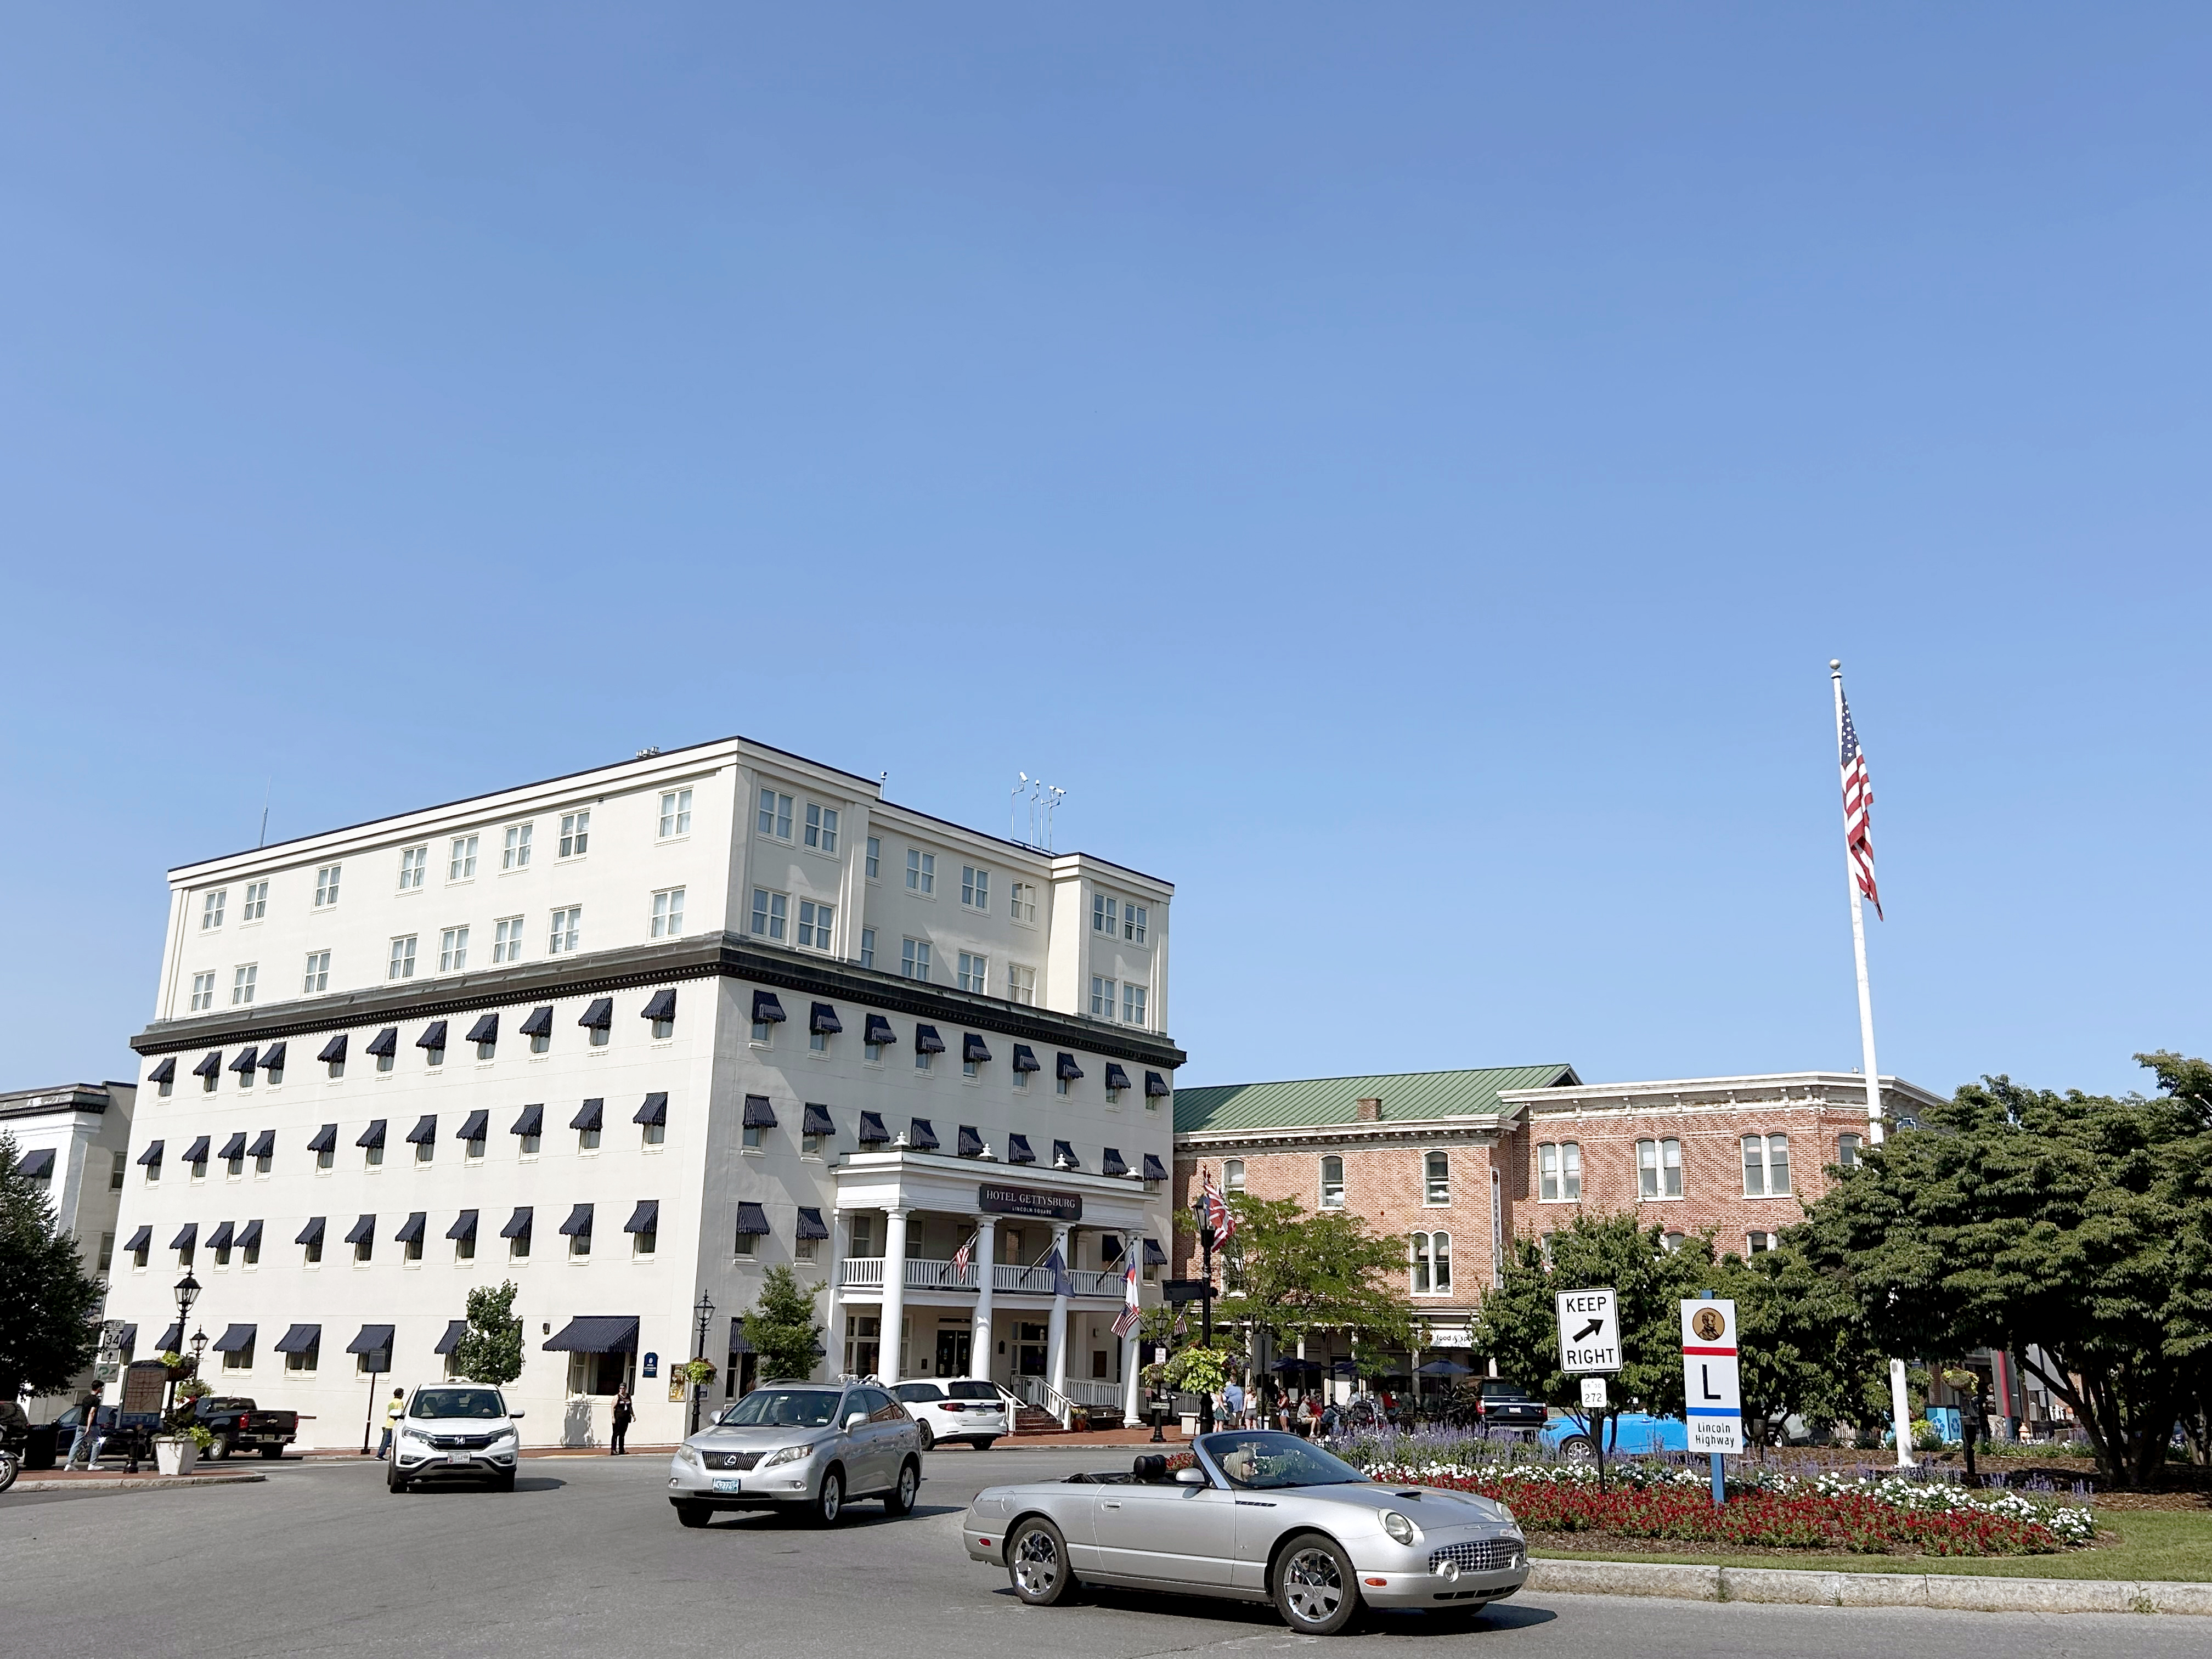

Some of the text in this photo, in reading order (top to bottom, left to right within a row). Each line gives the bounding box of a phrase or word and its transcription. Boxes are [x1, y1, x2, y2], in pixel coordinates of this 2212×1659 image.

[986, 1190, 1075, 1209] HOTEL GETTYSBURG
[1566, 1296, 1606, 1313] KEEP
[106, 1334, 120, 1345] 34
[1567, 1348, 1614, 1365] RIGHT
[1702, 1364, 1722, 1400] L
[1585, 1393, 1602, 1403] 272
[1698, 1422, 1730, 1433] Lincoln
[1695, 1434, 1734, 1448] Highway
